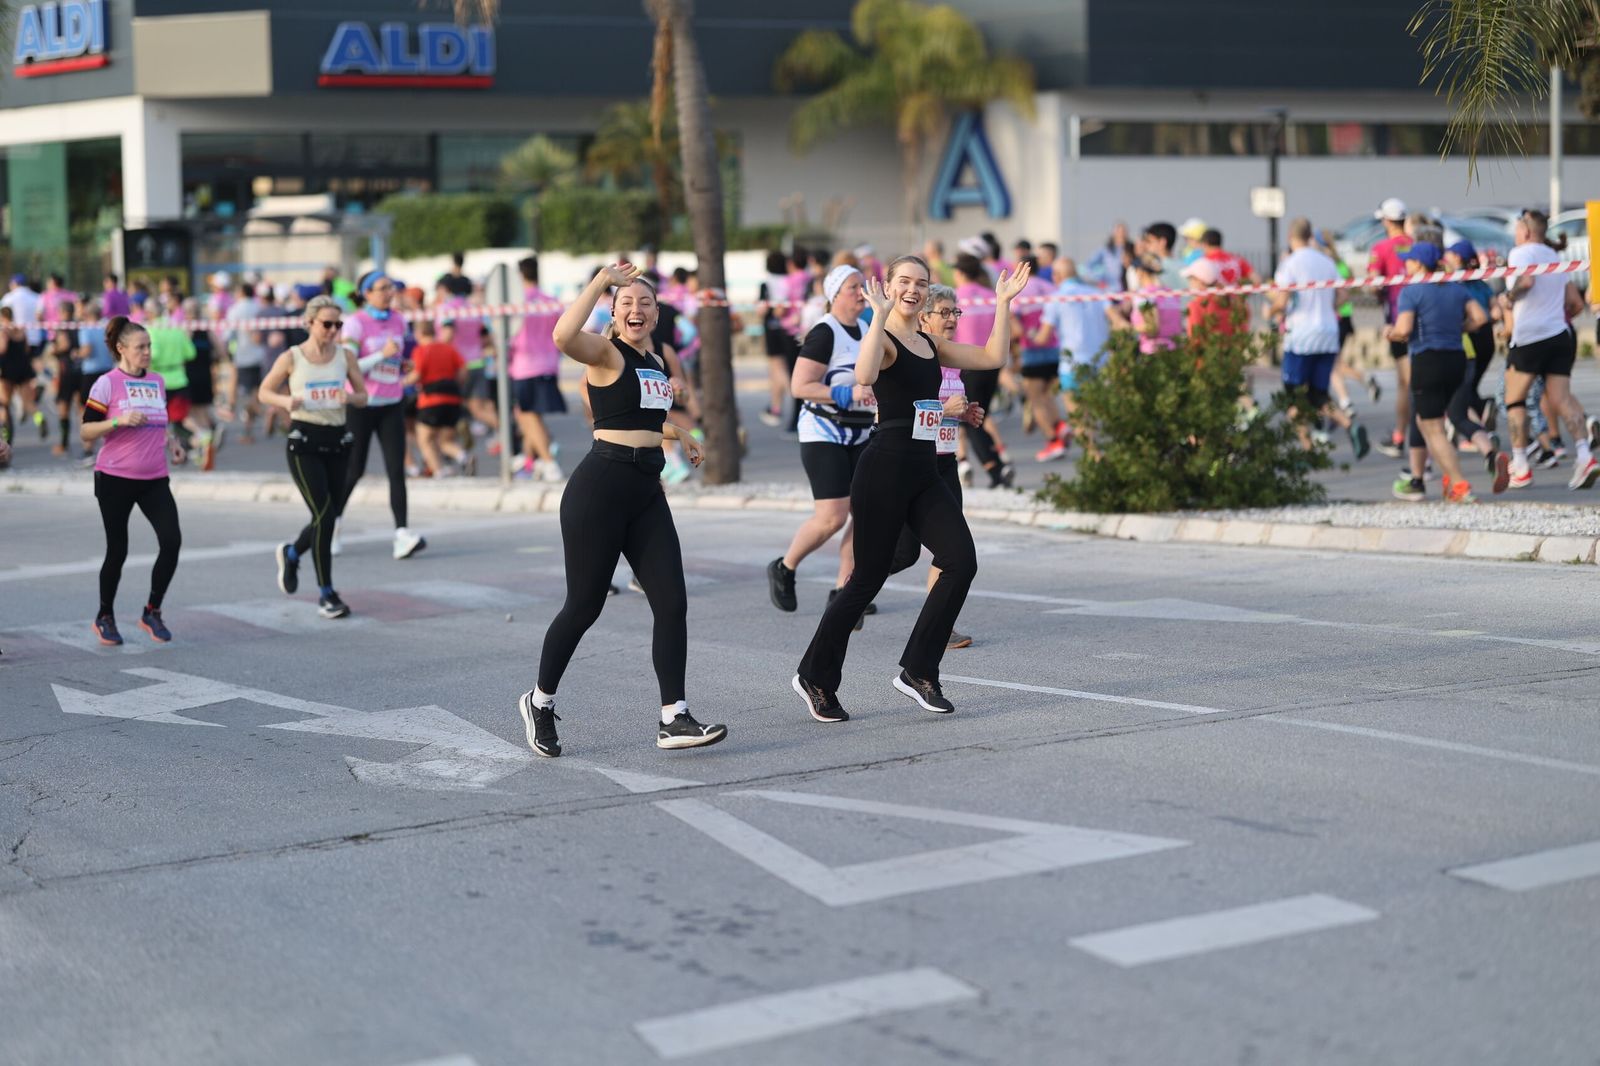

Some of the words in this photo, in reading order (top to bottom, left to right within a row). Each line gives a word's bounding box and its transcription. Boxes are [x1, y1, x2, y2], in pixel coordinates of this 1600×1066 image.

[14, 0, 110, 64] ALDI
[320, 21, 496, 75] ALDI
[129, 387, 158, 399] 2157
[643, 379, 673, 400] 1135
[938, 427, 956, 441] 682
